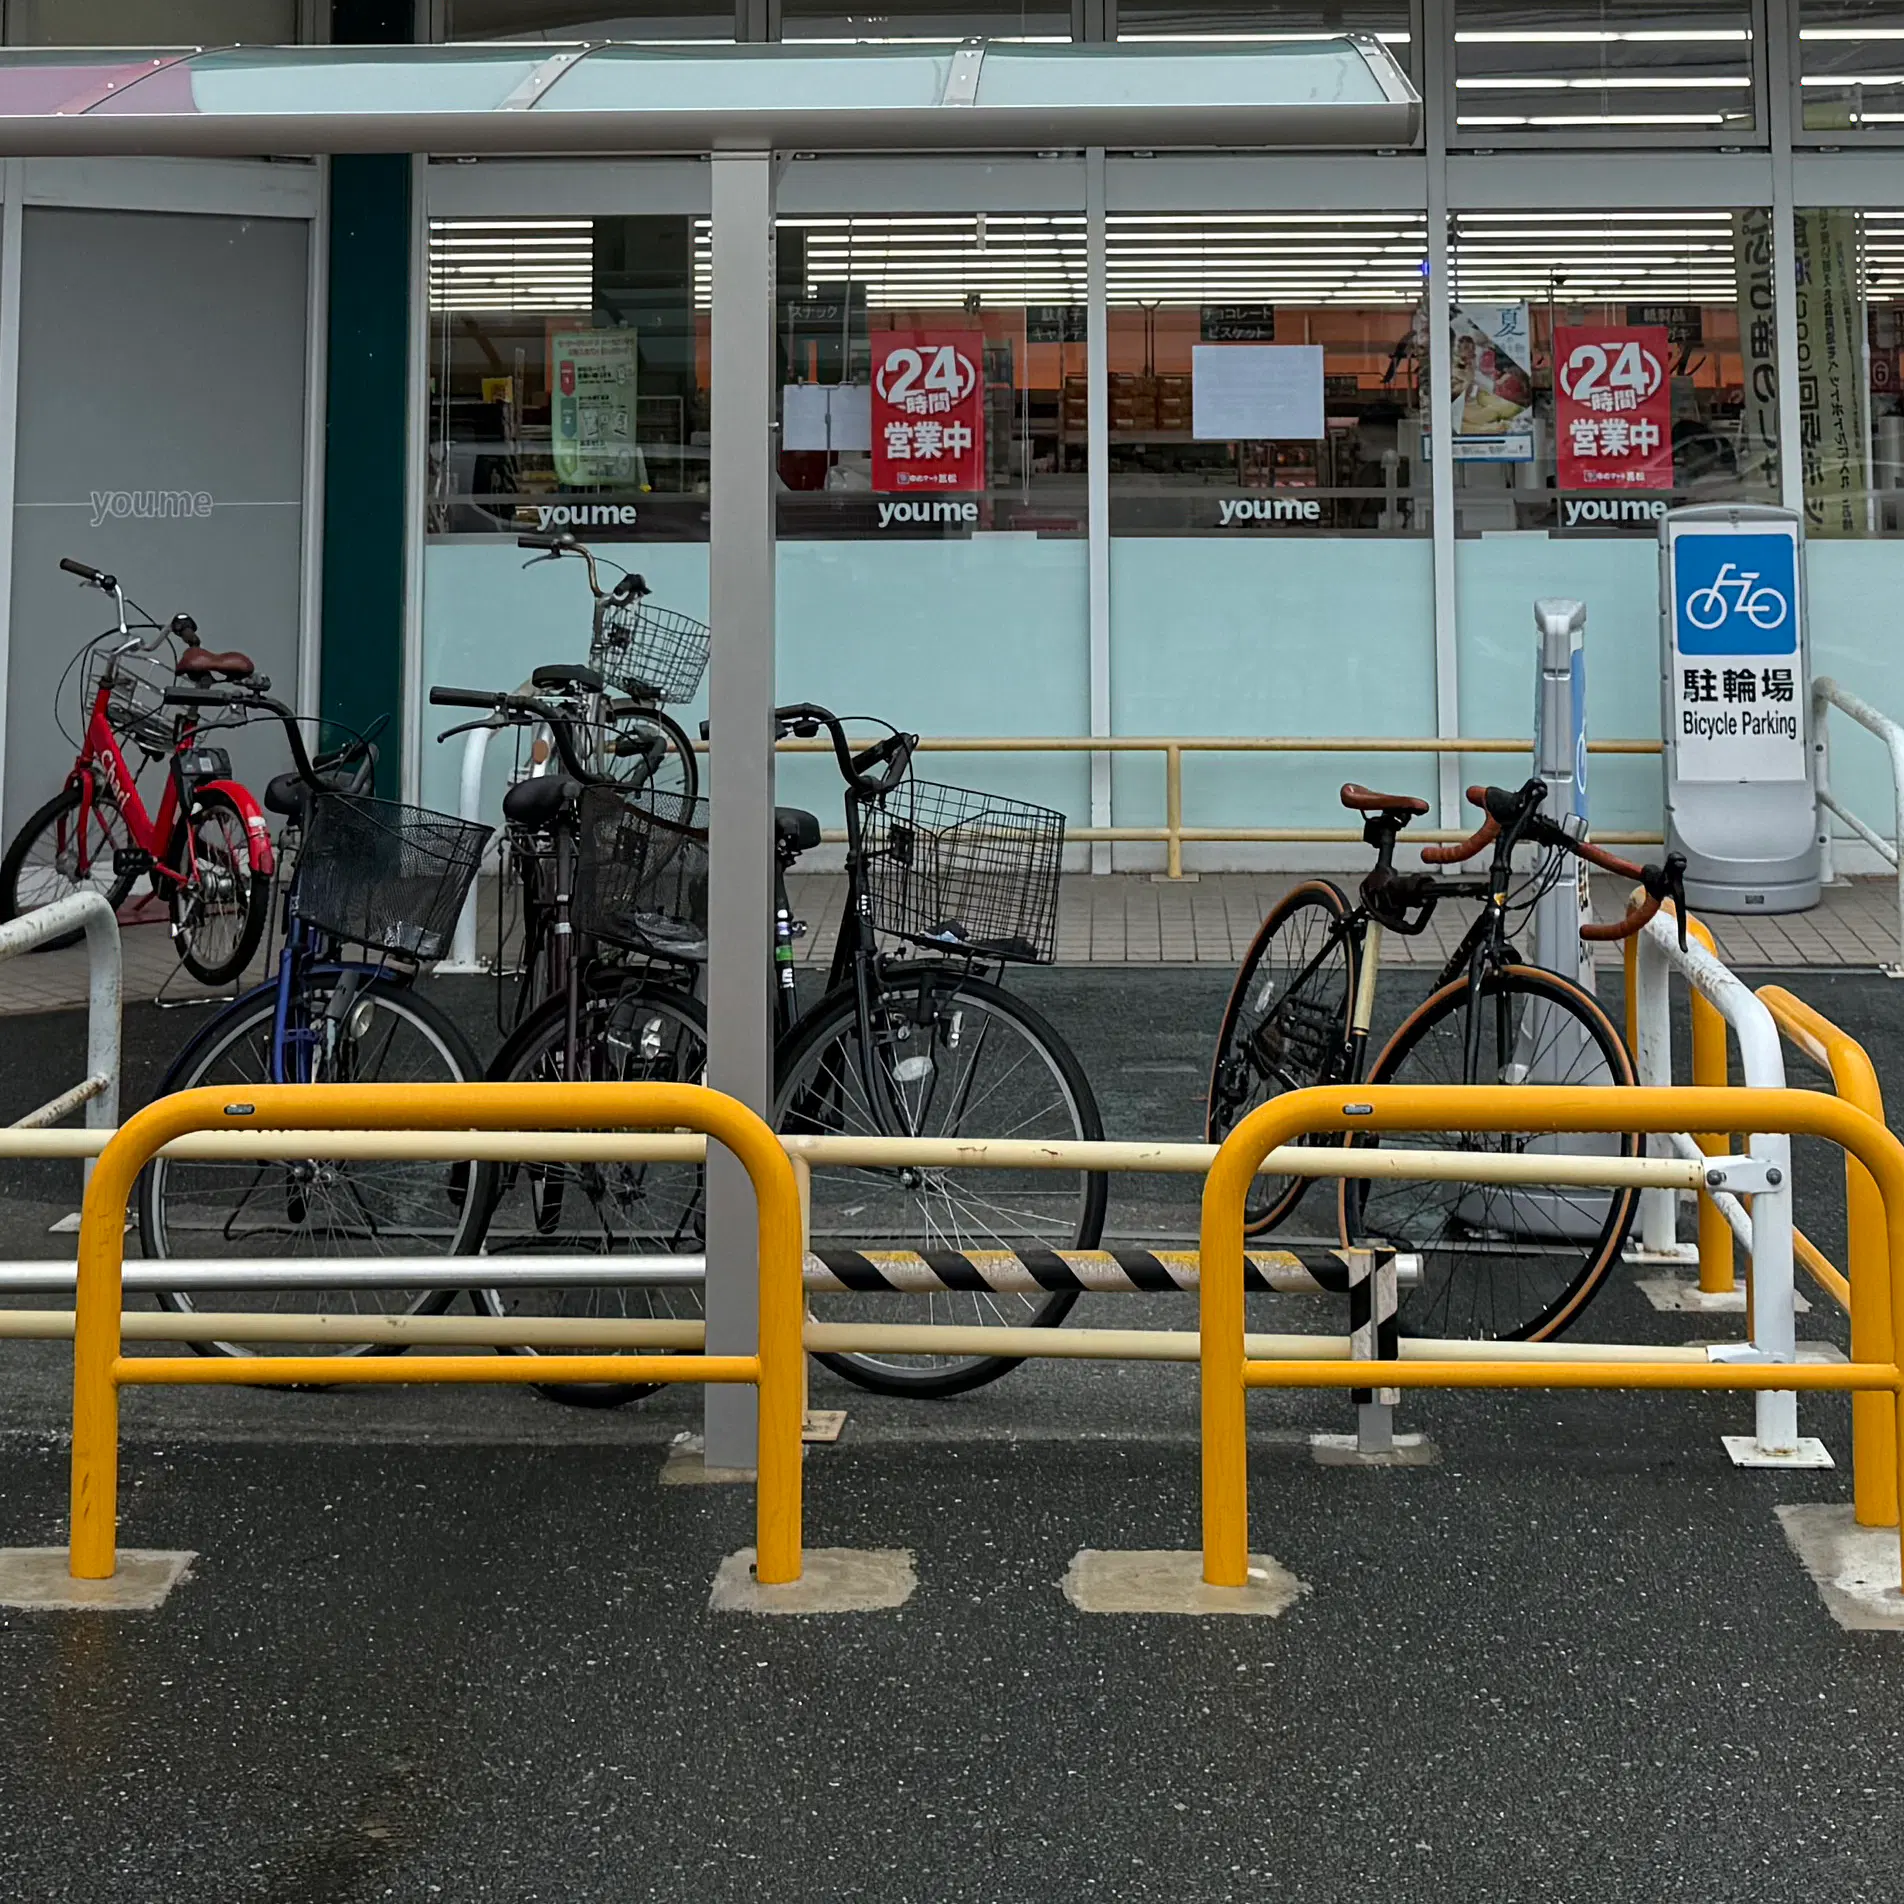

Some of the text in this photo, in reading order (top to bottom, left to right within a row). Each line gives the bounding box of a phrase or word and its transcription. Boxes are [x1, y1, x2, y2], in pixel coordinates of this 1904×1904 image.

[1493, 307, 1526, 337] 夏
[885, 346, 963, 404] 24
[1568, 342, 1649, 400] 24
[906, 393, 950, 414] 時間
[1591, 389, 1637, 411] 時間
[884, 421, 972, 459] 営業中
[1569, 418, 1659, 457] 営業中
[90, 490, 214, 527] youme
[537, 502, 637, 529] youme
[878, 500, 978, 528] youme
[1219, 497, 1321, 525] youme
[1565, 499, 1667, 526] youme
[1683, 667, 1796, 704] 駐輪場
[1683, 710, 1797, 741] Bicycle Parking
